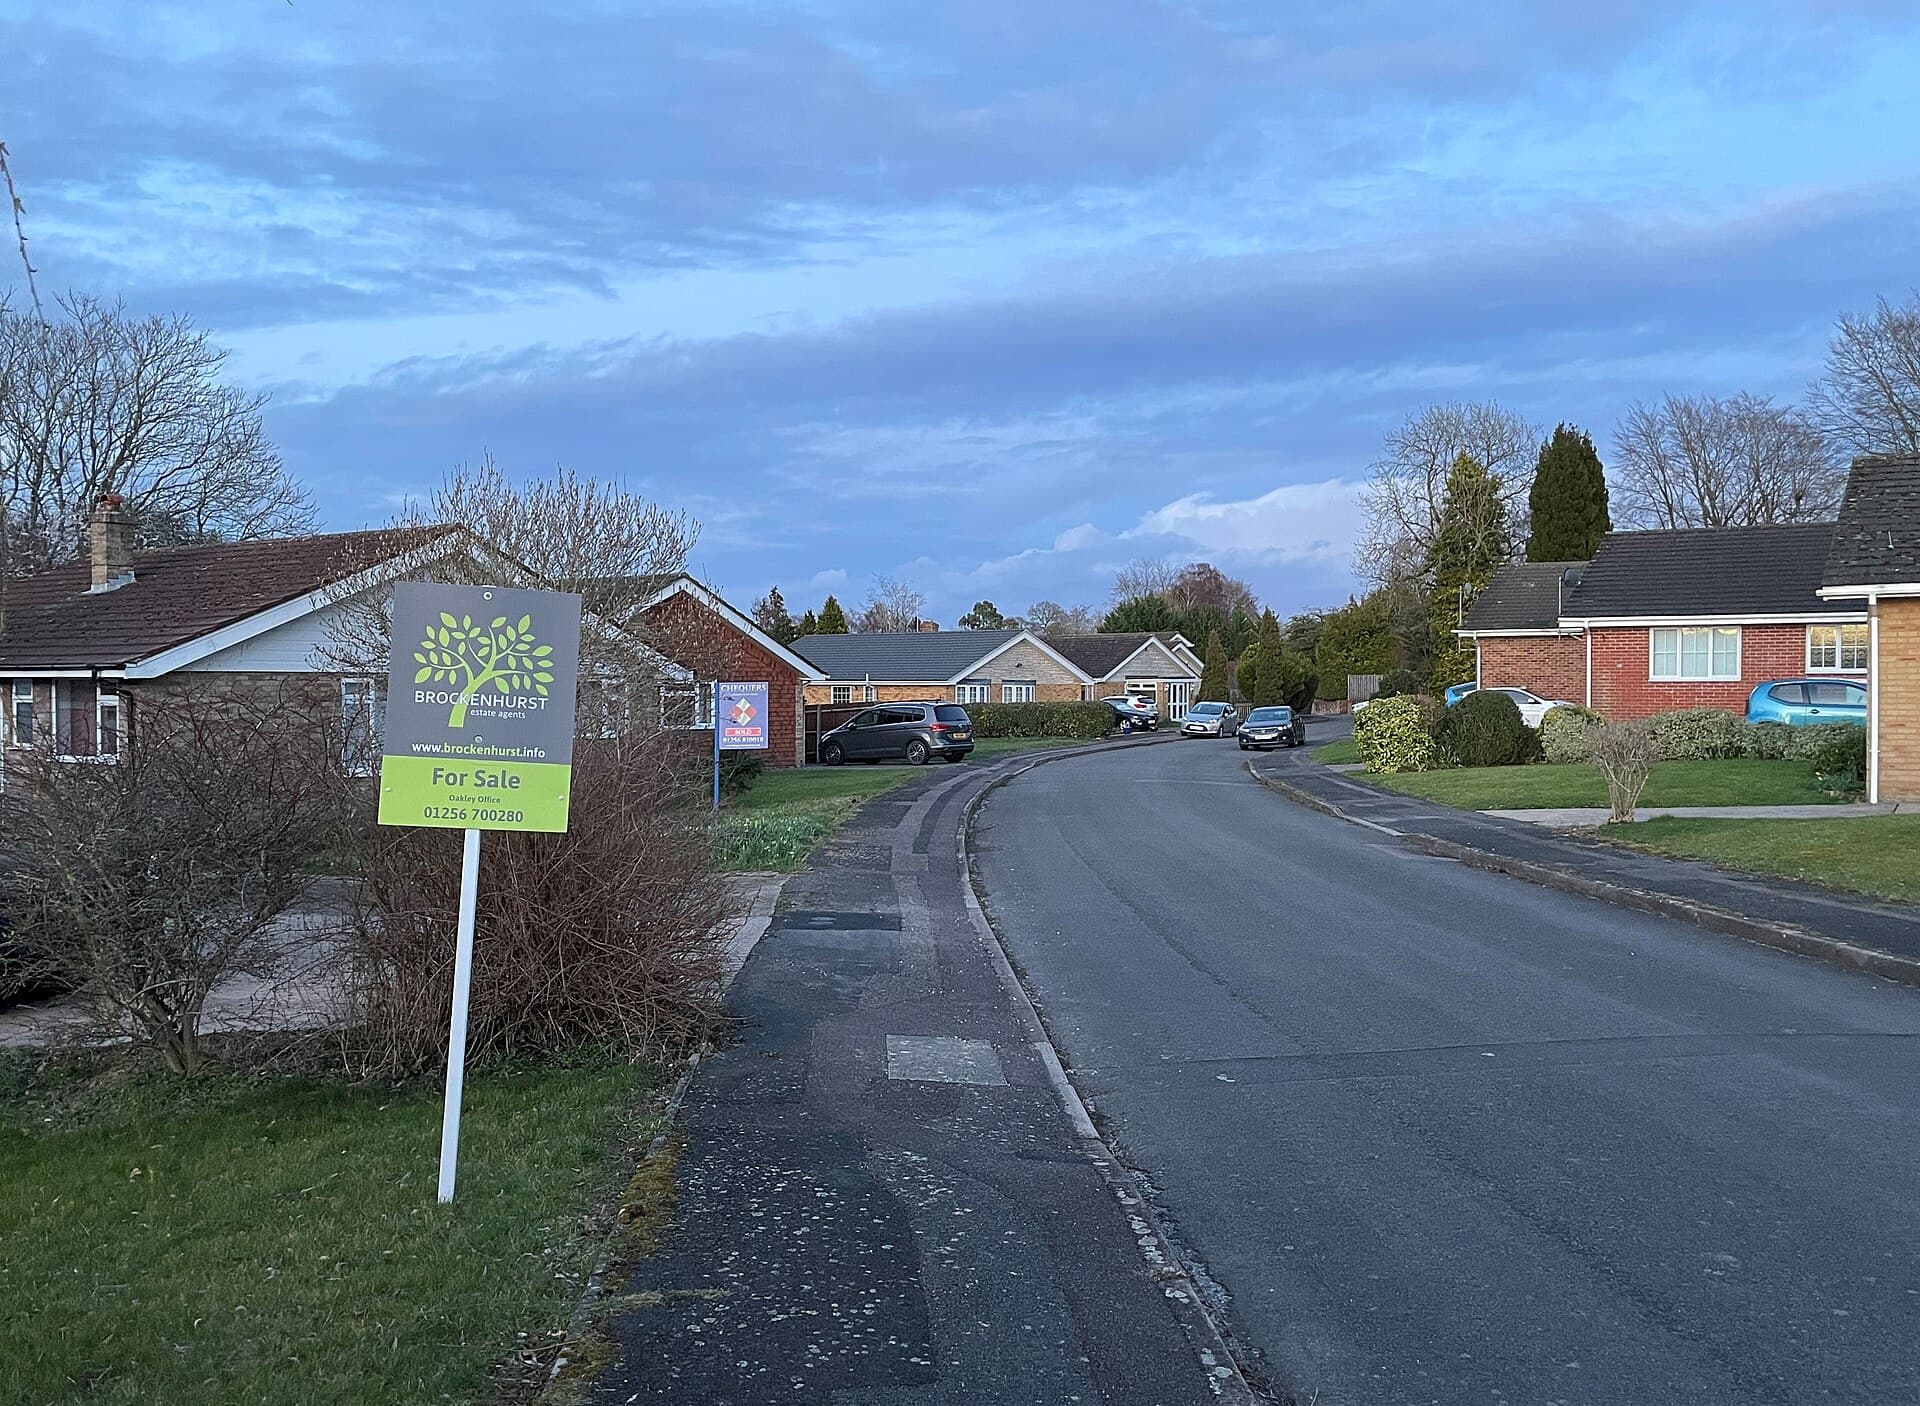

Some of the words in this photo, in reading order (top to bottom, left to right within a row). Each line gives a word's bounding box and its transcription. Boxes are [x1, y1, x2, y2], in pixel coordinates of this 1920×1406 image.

[414, 690, 549, 710] BROCKENHURST
[470, 708, 497, 717] estate
[498, 709, 526, 720] agents
[411, 742, 546, 758] www.brockenhurst.info
[432, 767, 468, 787] For
[473, 769, 521, 789] Sale
[448, 794, 476, 804] Oakley
[477, 795, 501, 804] Office
[423, 806, 467, 821] 01256
[471, 808, 524, 823] 700280
